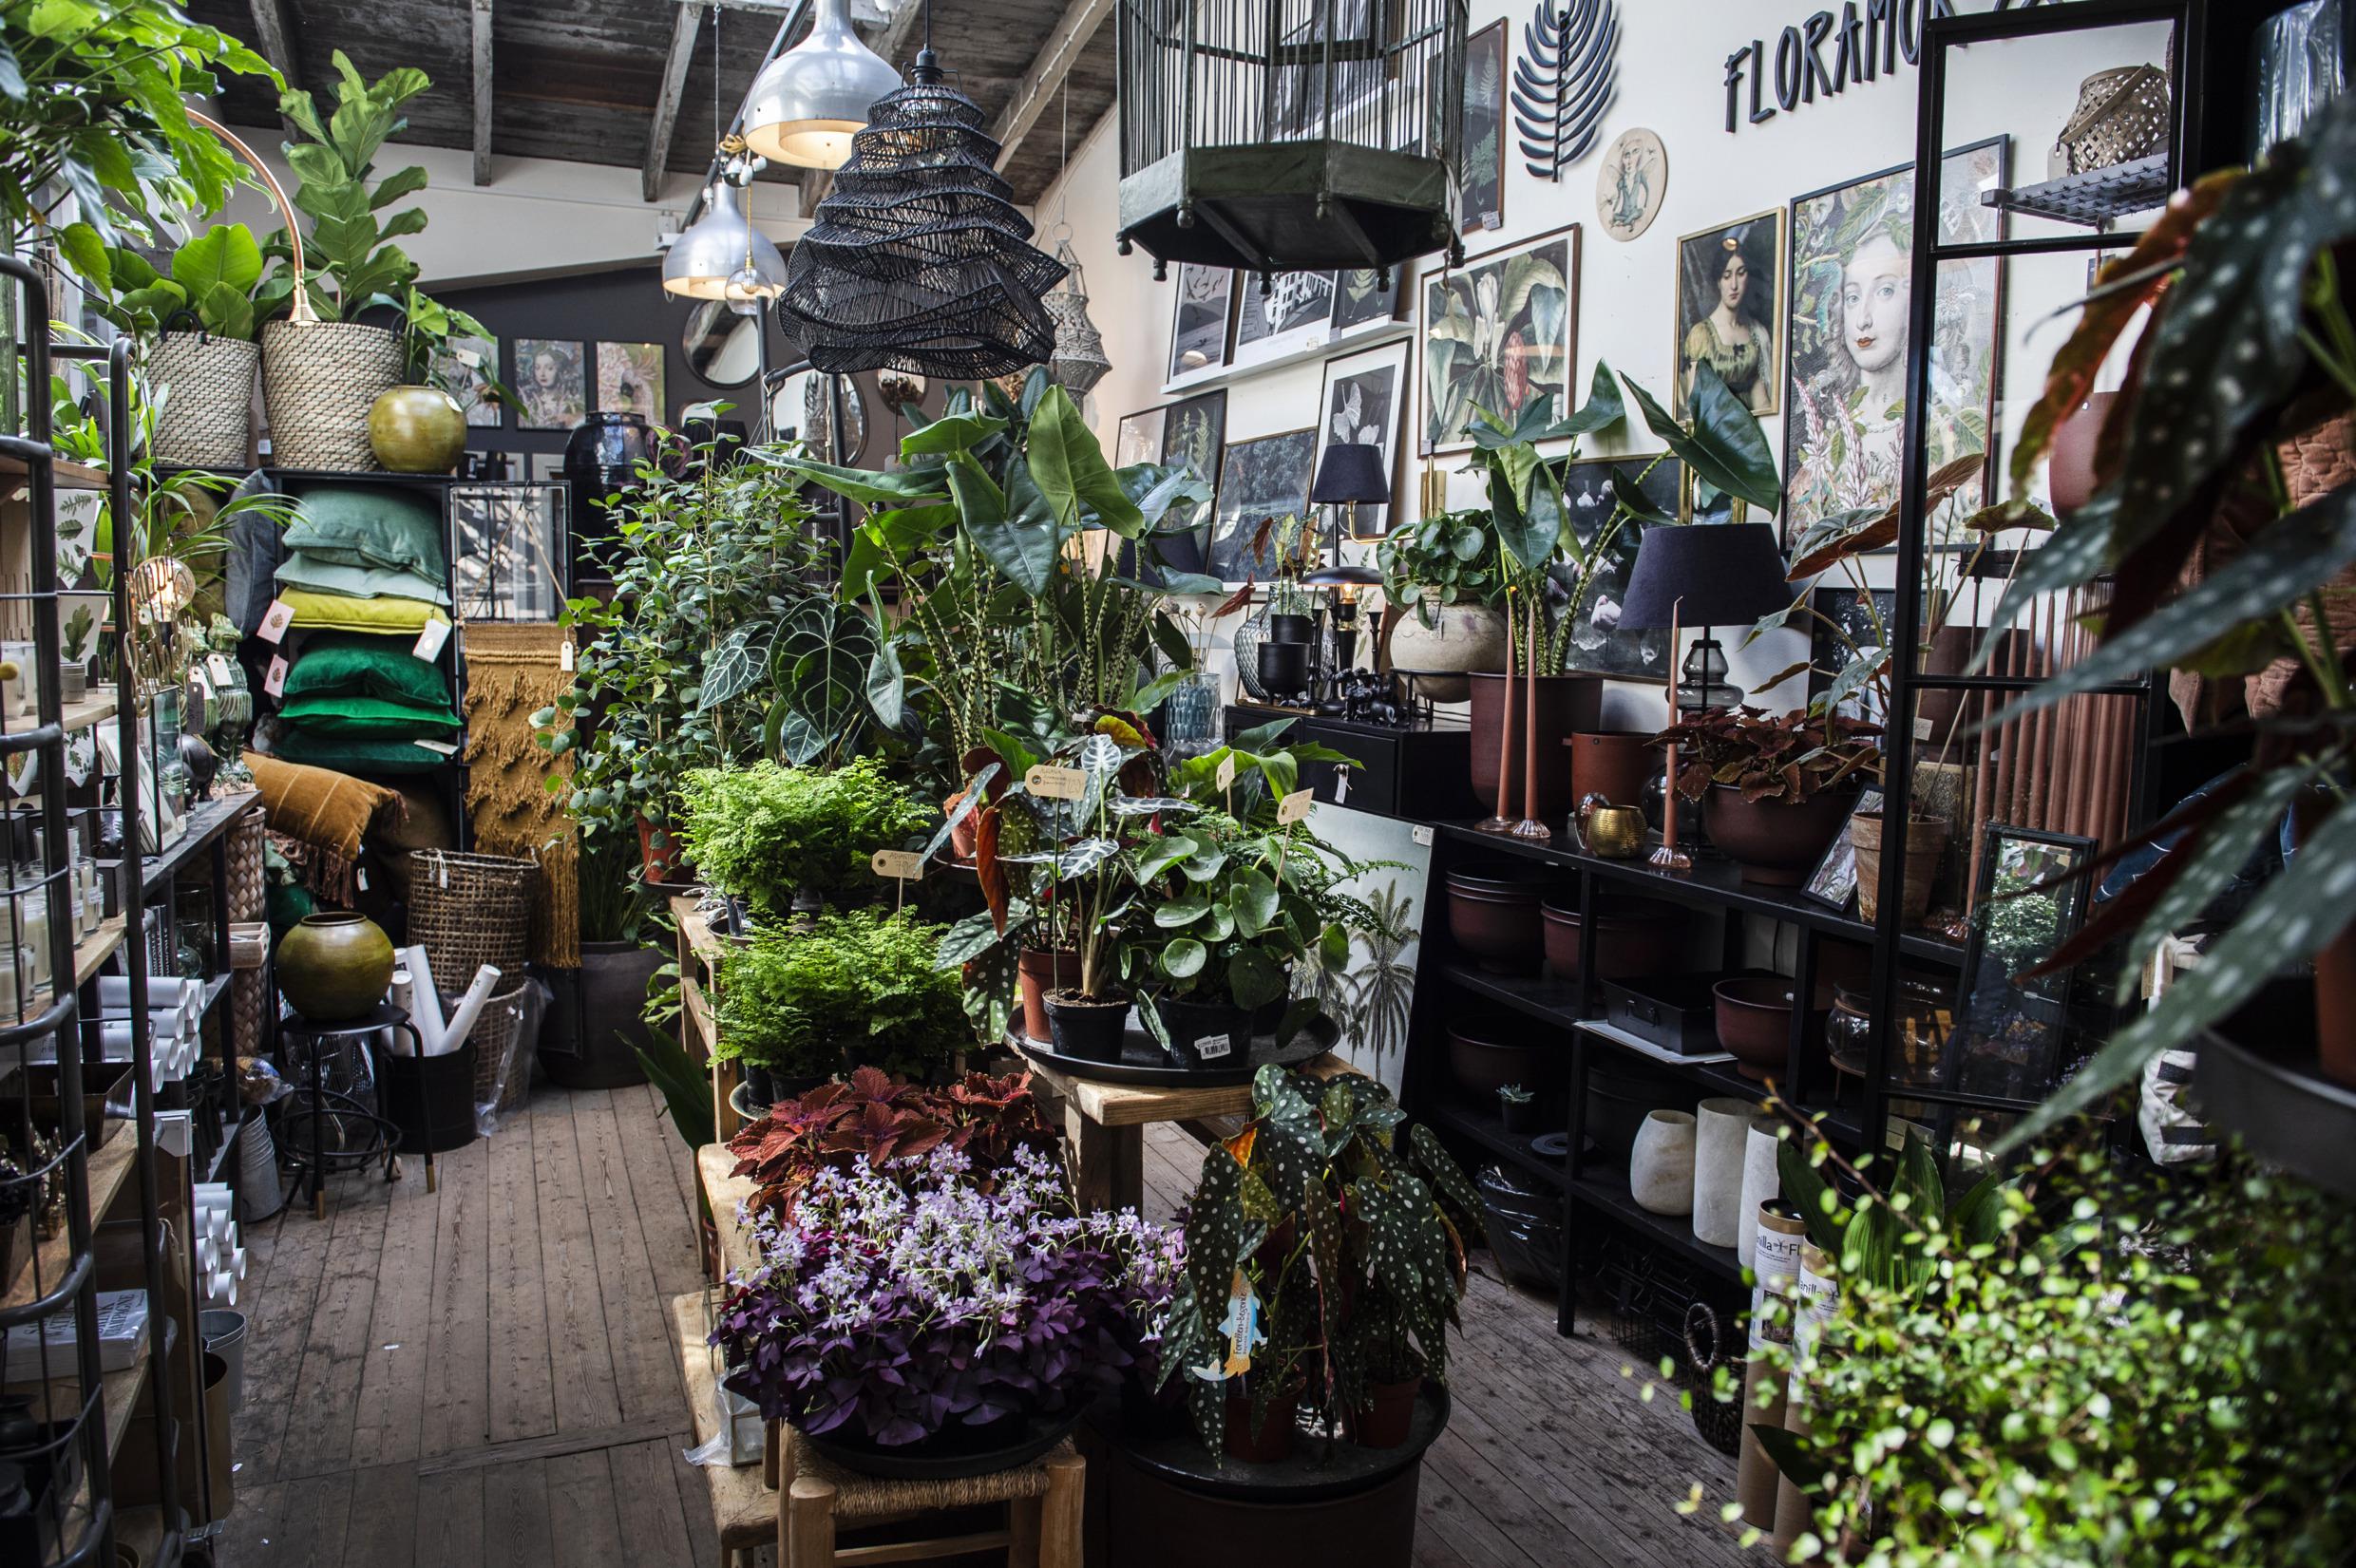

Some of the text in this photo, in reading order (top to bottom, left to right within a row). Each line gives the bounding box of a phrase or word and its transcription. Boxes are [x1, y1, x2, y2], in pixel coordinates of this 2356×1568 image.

[1715, 0, 1957, 132] FLORAMO
[1757, 1236, 1773, 1251] nilla
[104, 1293, 135, 1336] CHAMPAGNE
